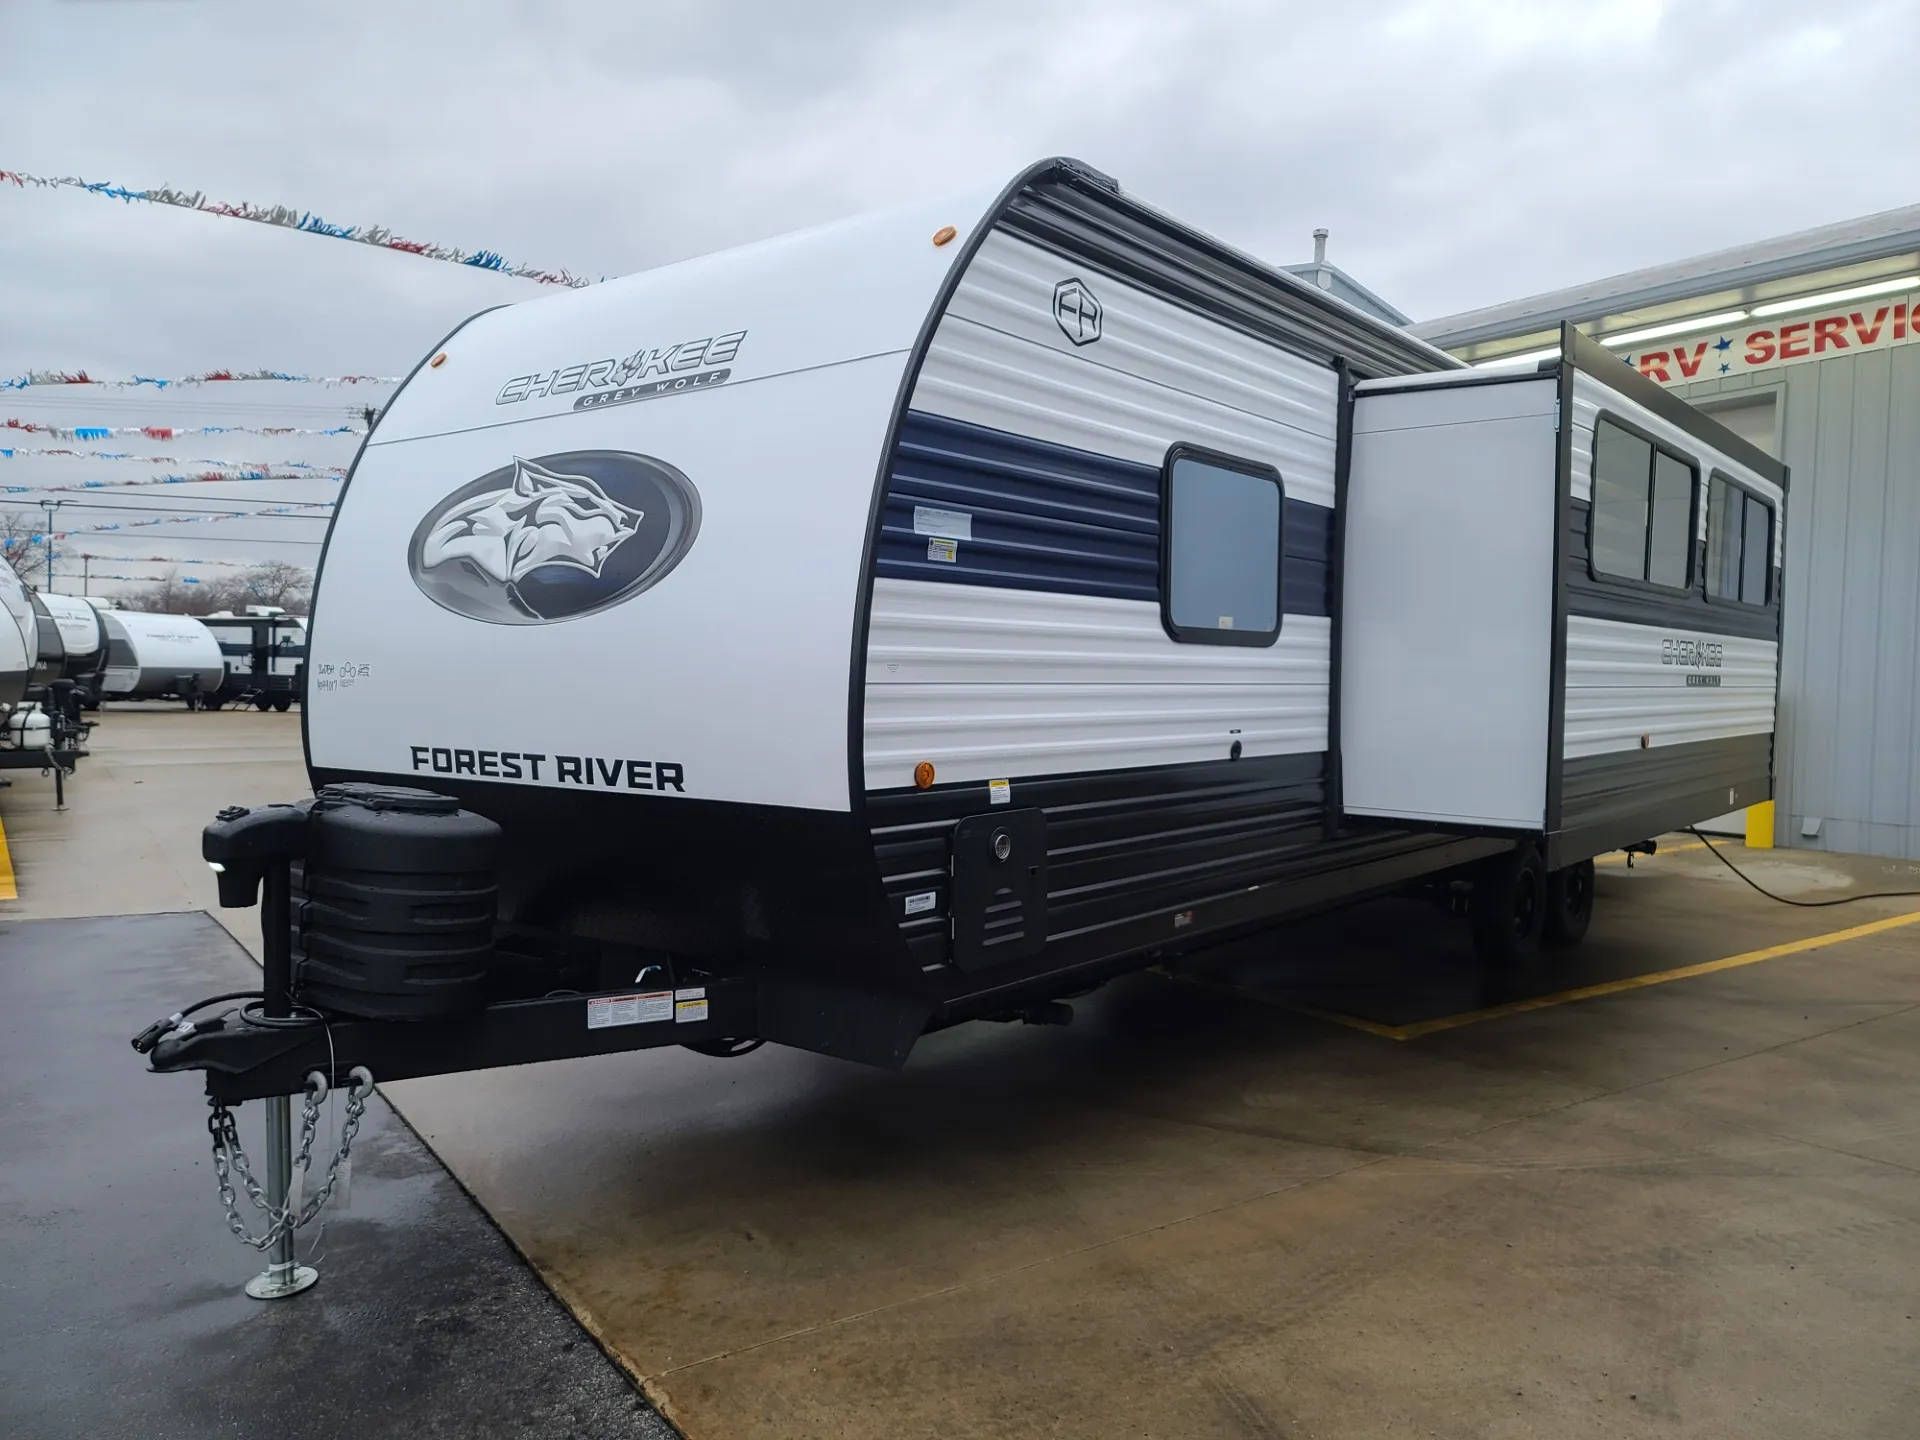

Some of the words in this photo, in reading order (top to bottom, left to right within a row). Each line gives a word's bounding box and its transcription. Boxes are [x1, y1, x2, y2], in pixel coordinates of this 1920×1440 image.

[1639, 342, 1709, 383] RV
[1744, 303, 1920, 365] SERVI
[583, 388, 640, 408] GREY
[656, 372, 721, 393] WOLF
[410, 745, 546, 781] FOREST
[555, 754, 686, 792] RIVER
